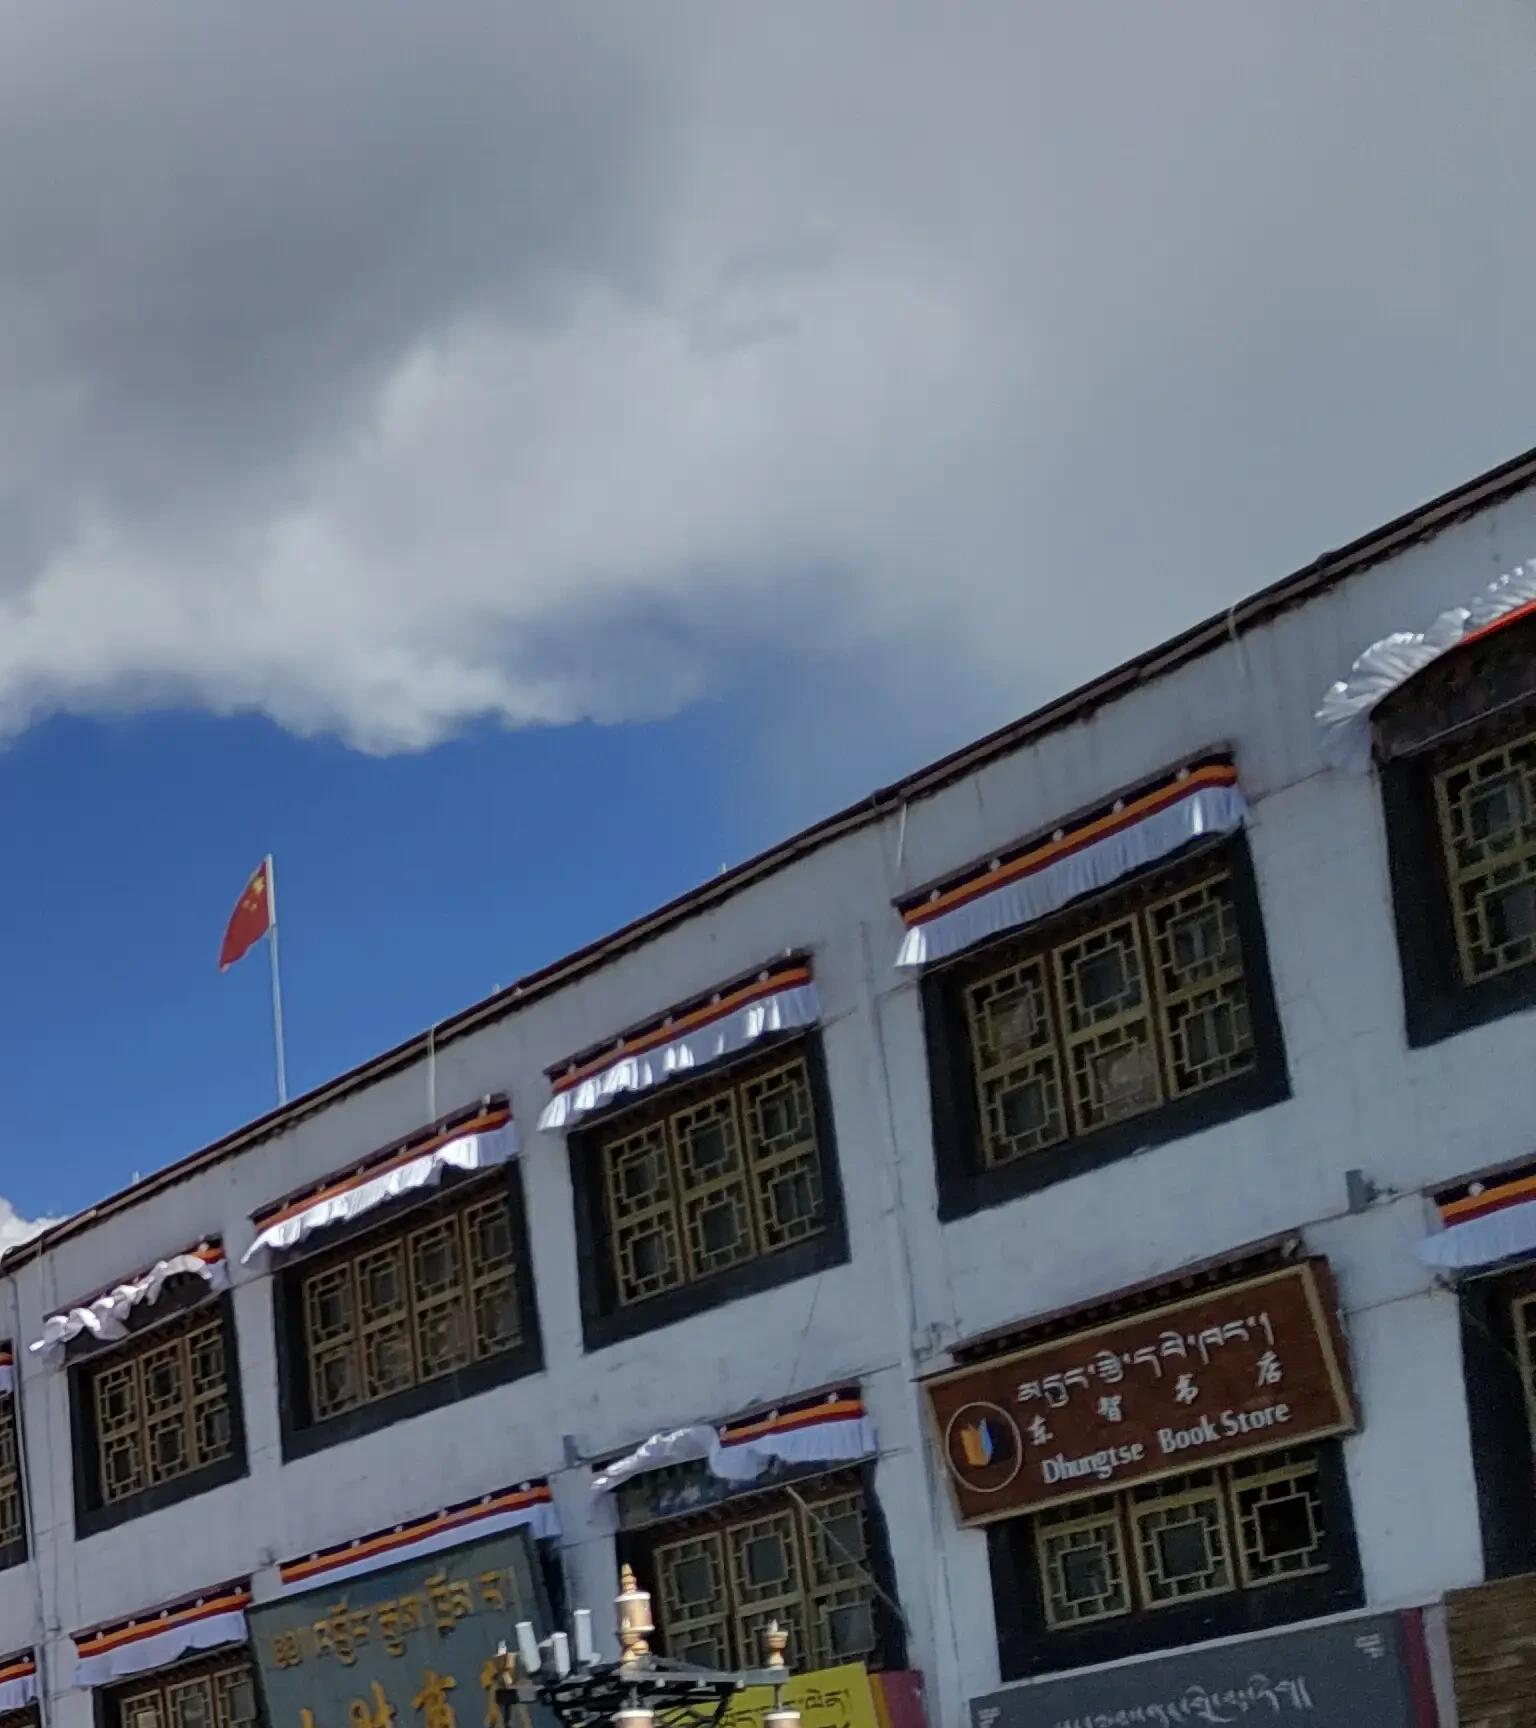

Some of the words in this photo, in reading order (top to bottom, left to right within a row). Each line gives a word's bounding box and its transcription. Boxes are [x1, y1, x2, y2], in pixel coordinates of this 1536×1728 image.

[1028, 1350, 1283, 1446] 东智书店
[1040, 1442, 1146, 1485] Dhungtse
[1157, 1415, 1220, 1454] Book
[1220, 1403, 1293, 1438] Store
